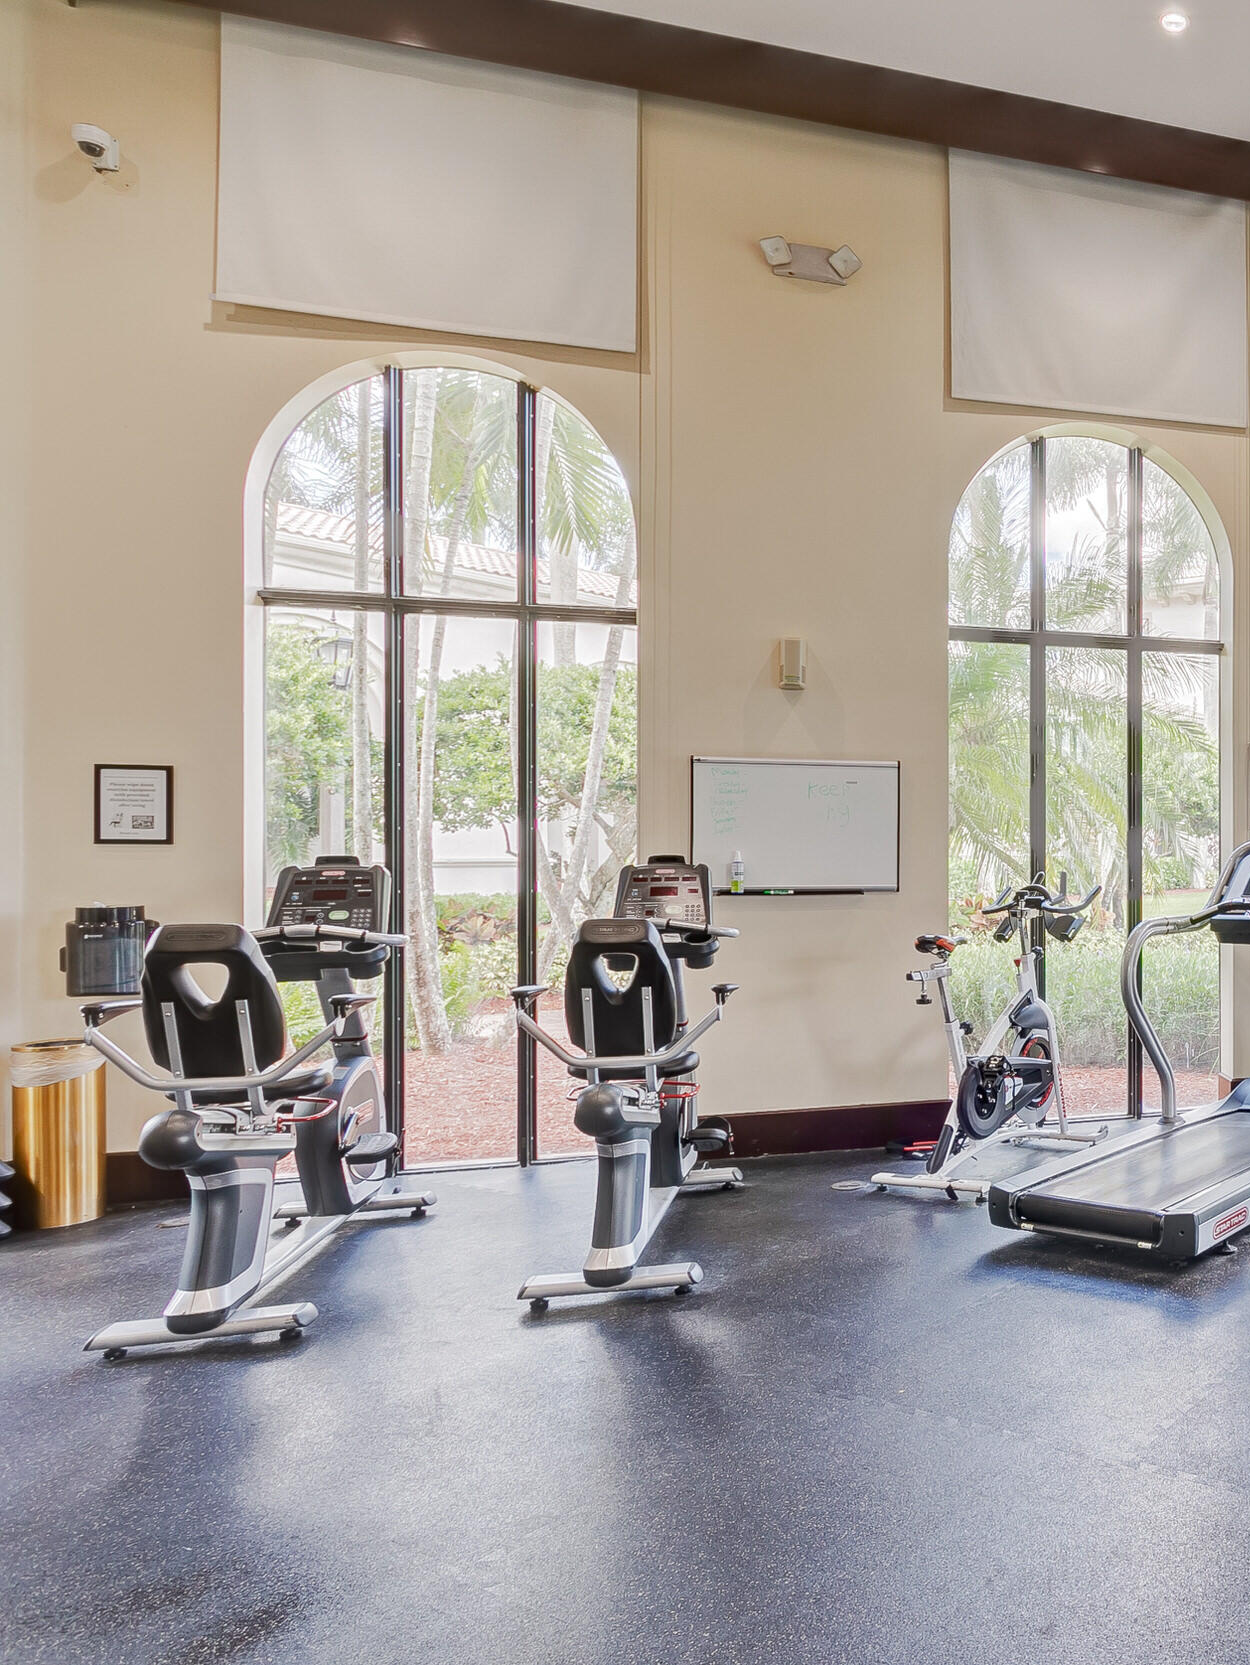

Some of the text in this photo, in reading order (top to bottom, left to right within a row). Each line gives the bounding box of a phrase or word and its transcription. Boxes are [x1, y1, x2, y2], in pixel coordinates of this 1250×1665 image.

[1057, 1063, 1067, 1118] SCHWINN
[1215, 1212, 1246, 1233] STAR TRAC
